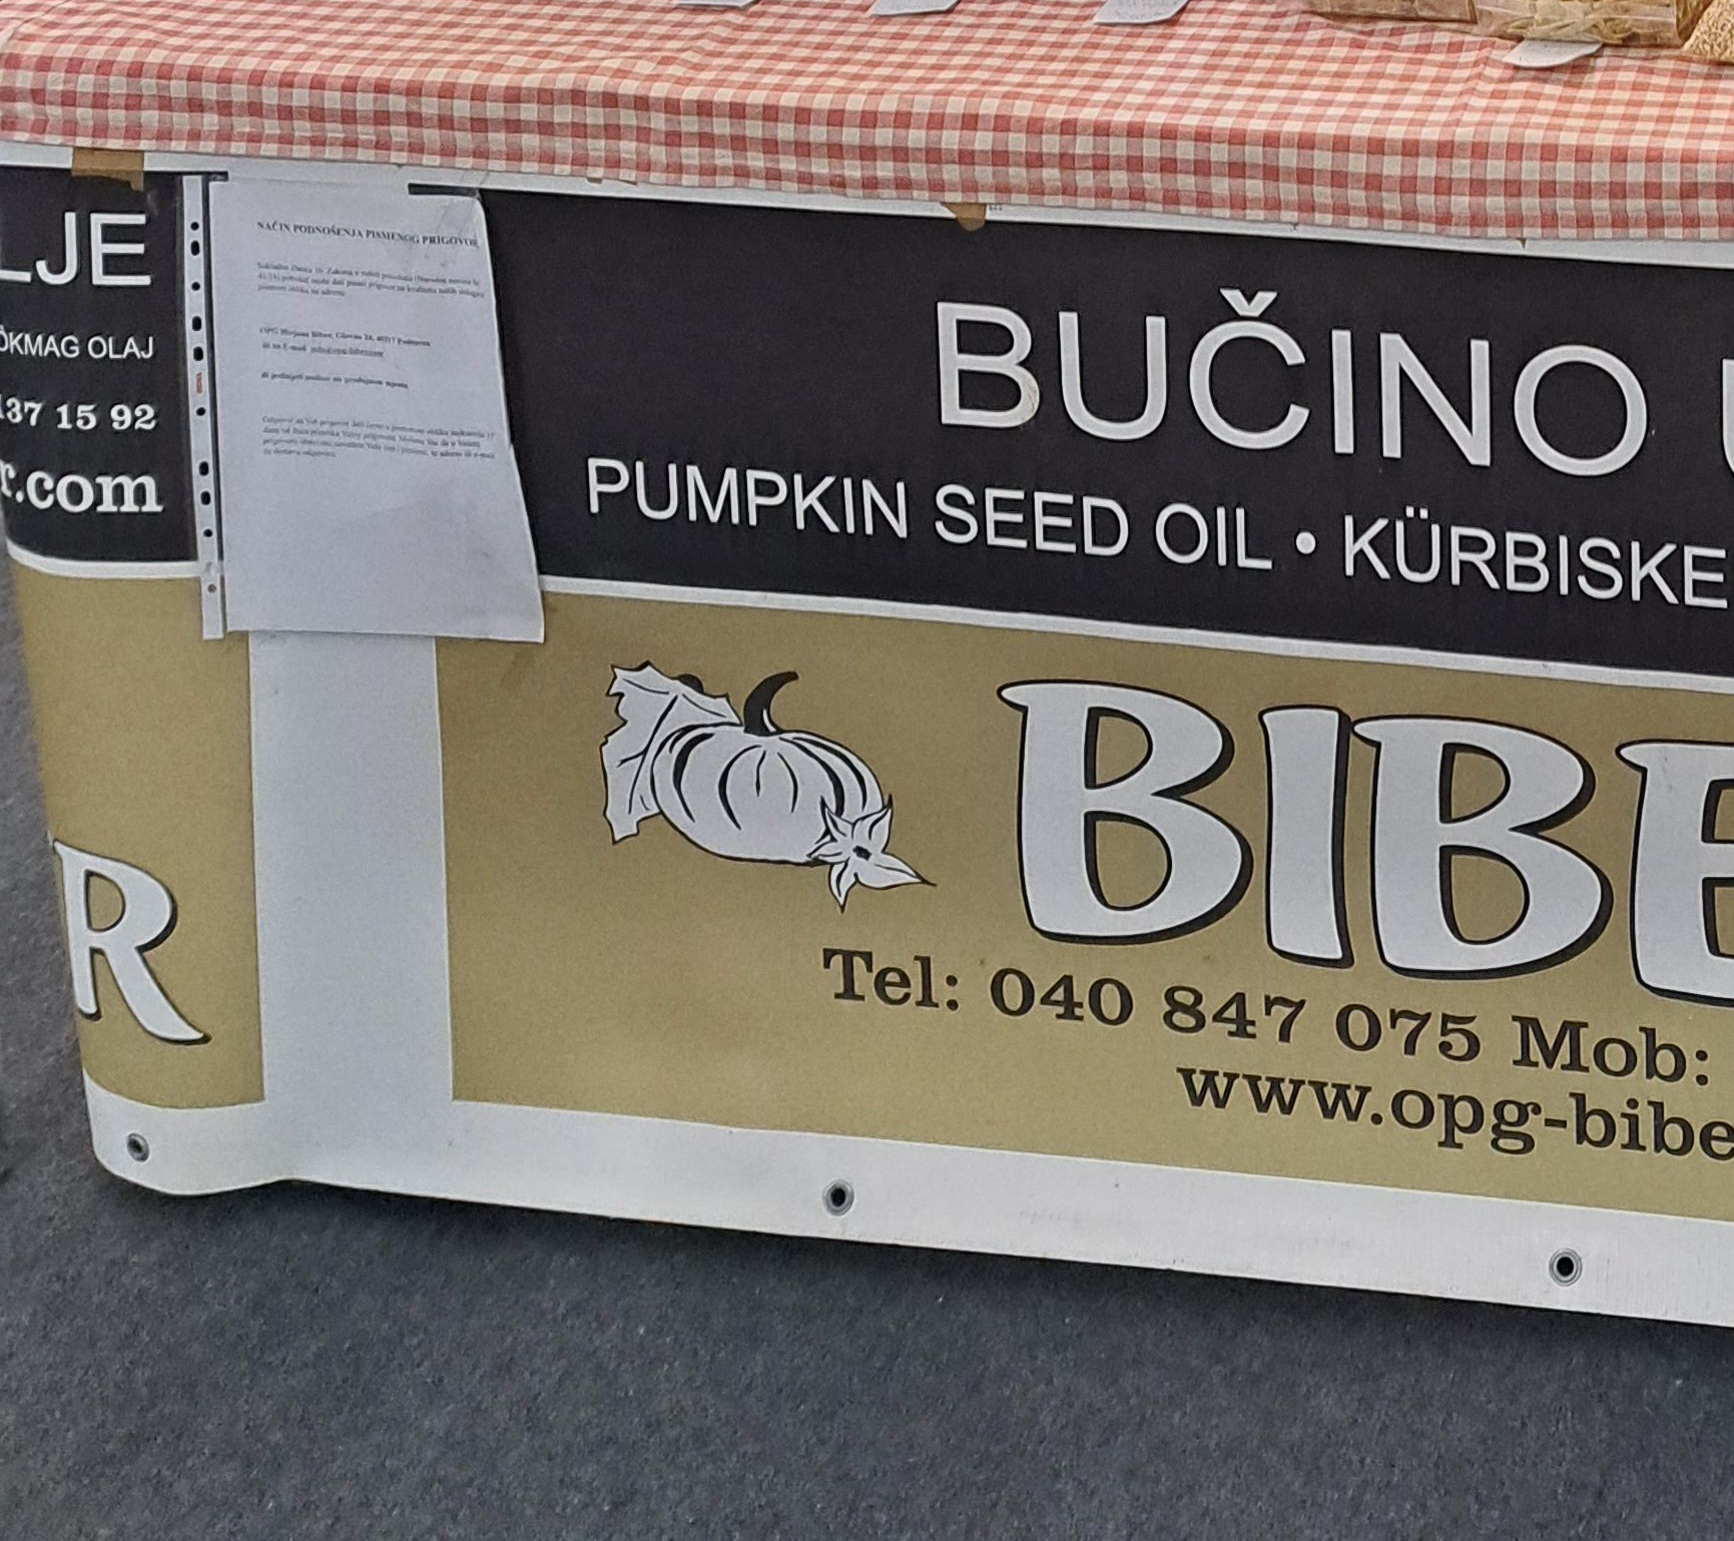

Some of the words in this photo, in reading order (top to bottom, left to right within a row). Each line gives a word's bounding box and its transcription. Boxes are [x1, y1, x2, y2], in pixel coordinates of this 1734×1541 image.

[257, 220, 291, 233] NAČIN
[293, 223, 364, 238] PODNOŠENJA
[365, 228, 420, 244] PISMENOG
[88, 335, 155, 359] OLAJ
[56, 403, 98, 430] 15
[110, 403, 157, 430] 92
[936, 289, 1648, 476] BUČINO
[588, 457, 908, 540] PUMPKIN
[935, 484, 1131, 557] SEED
[1154, 503, 1273, 571] OIL
[823, 948, 961, 1011] Tel:
[990, 967, 1134, 1025] 040
[1163, 985, 1308, 1044] 847
[1336, 1003, 1482, 1063] 075
[1511, 1015, 1710, 1087] Mob:
